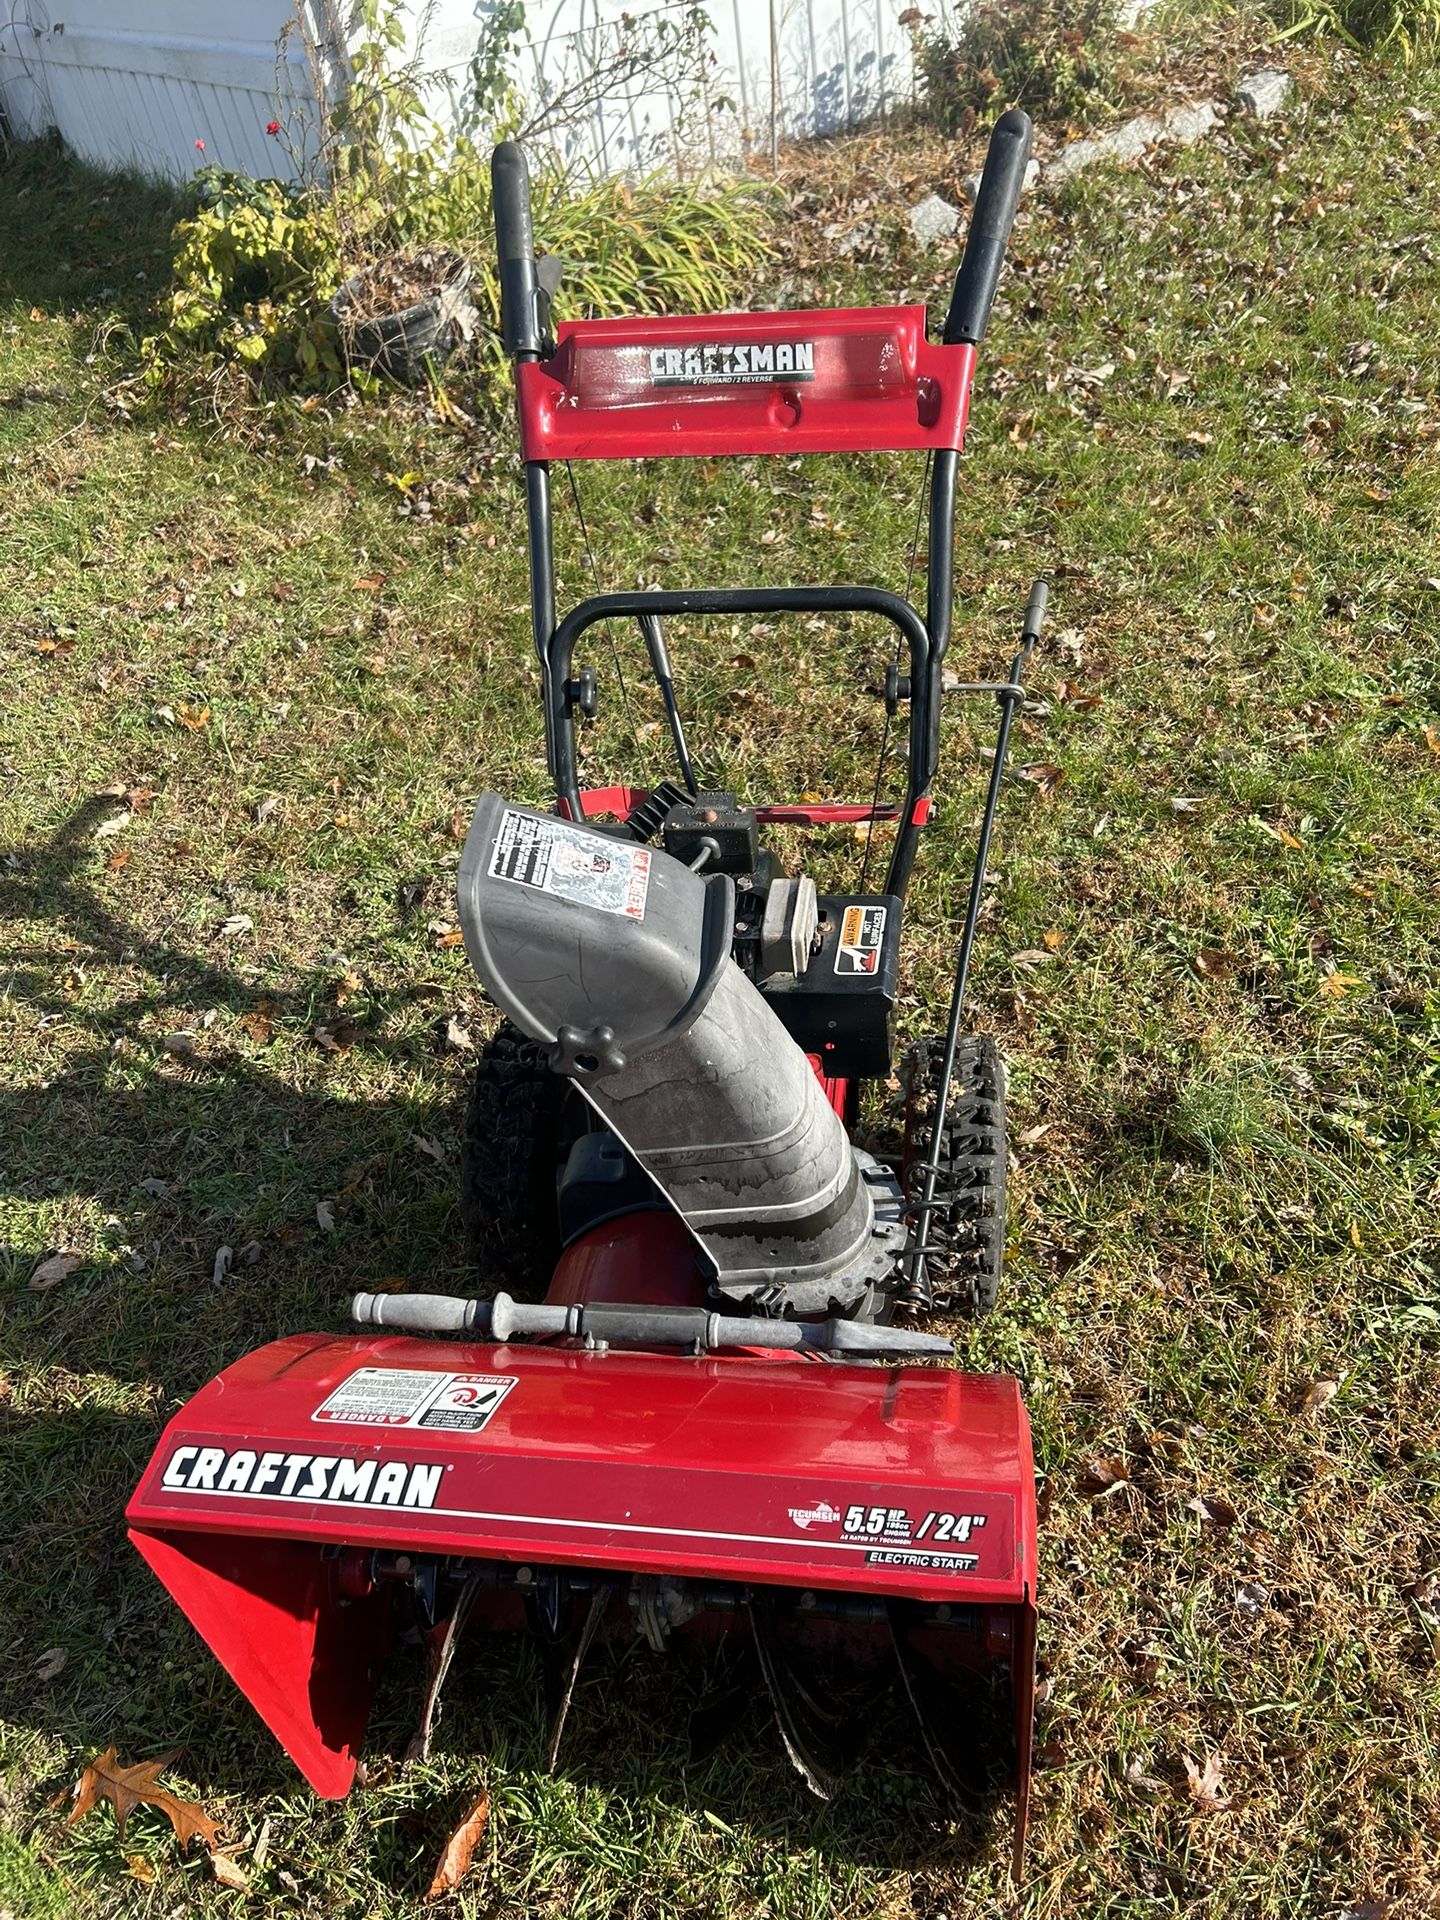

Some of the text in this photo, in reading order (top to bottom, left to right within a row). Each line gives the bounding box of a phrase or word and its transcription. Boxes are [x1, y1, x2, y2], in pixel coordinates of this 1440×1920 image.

[650, 343, 813, 375] CRAFTSMAN
[742, 375, 774, 383] REVERSE
[846, 908, 860, 941] WARNING
[863, 921, 872, 934] HOT
[870, 912, 883, 945] SURFACES
[469, 1376, 512, 1385] DANGER
[330, 1412, 385, 1423] DANGER
[161, 1445, 443, 1508] CRAFTSMAN
[788, 1508, 841, 1522] TECUMSEH
[843, 1505, 906, 1535] 5.5 HP
[849, 1534, 869, 1542] RATED
[879, 1537, 912, 1545] TECUMSEH
[883, 1529, 911, 1538] ENGINE
[869, 1551, 972, 1570] ELECTRIC START
